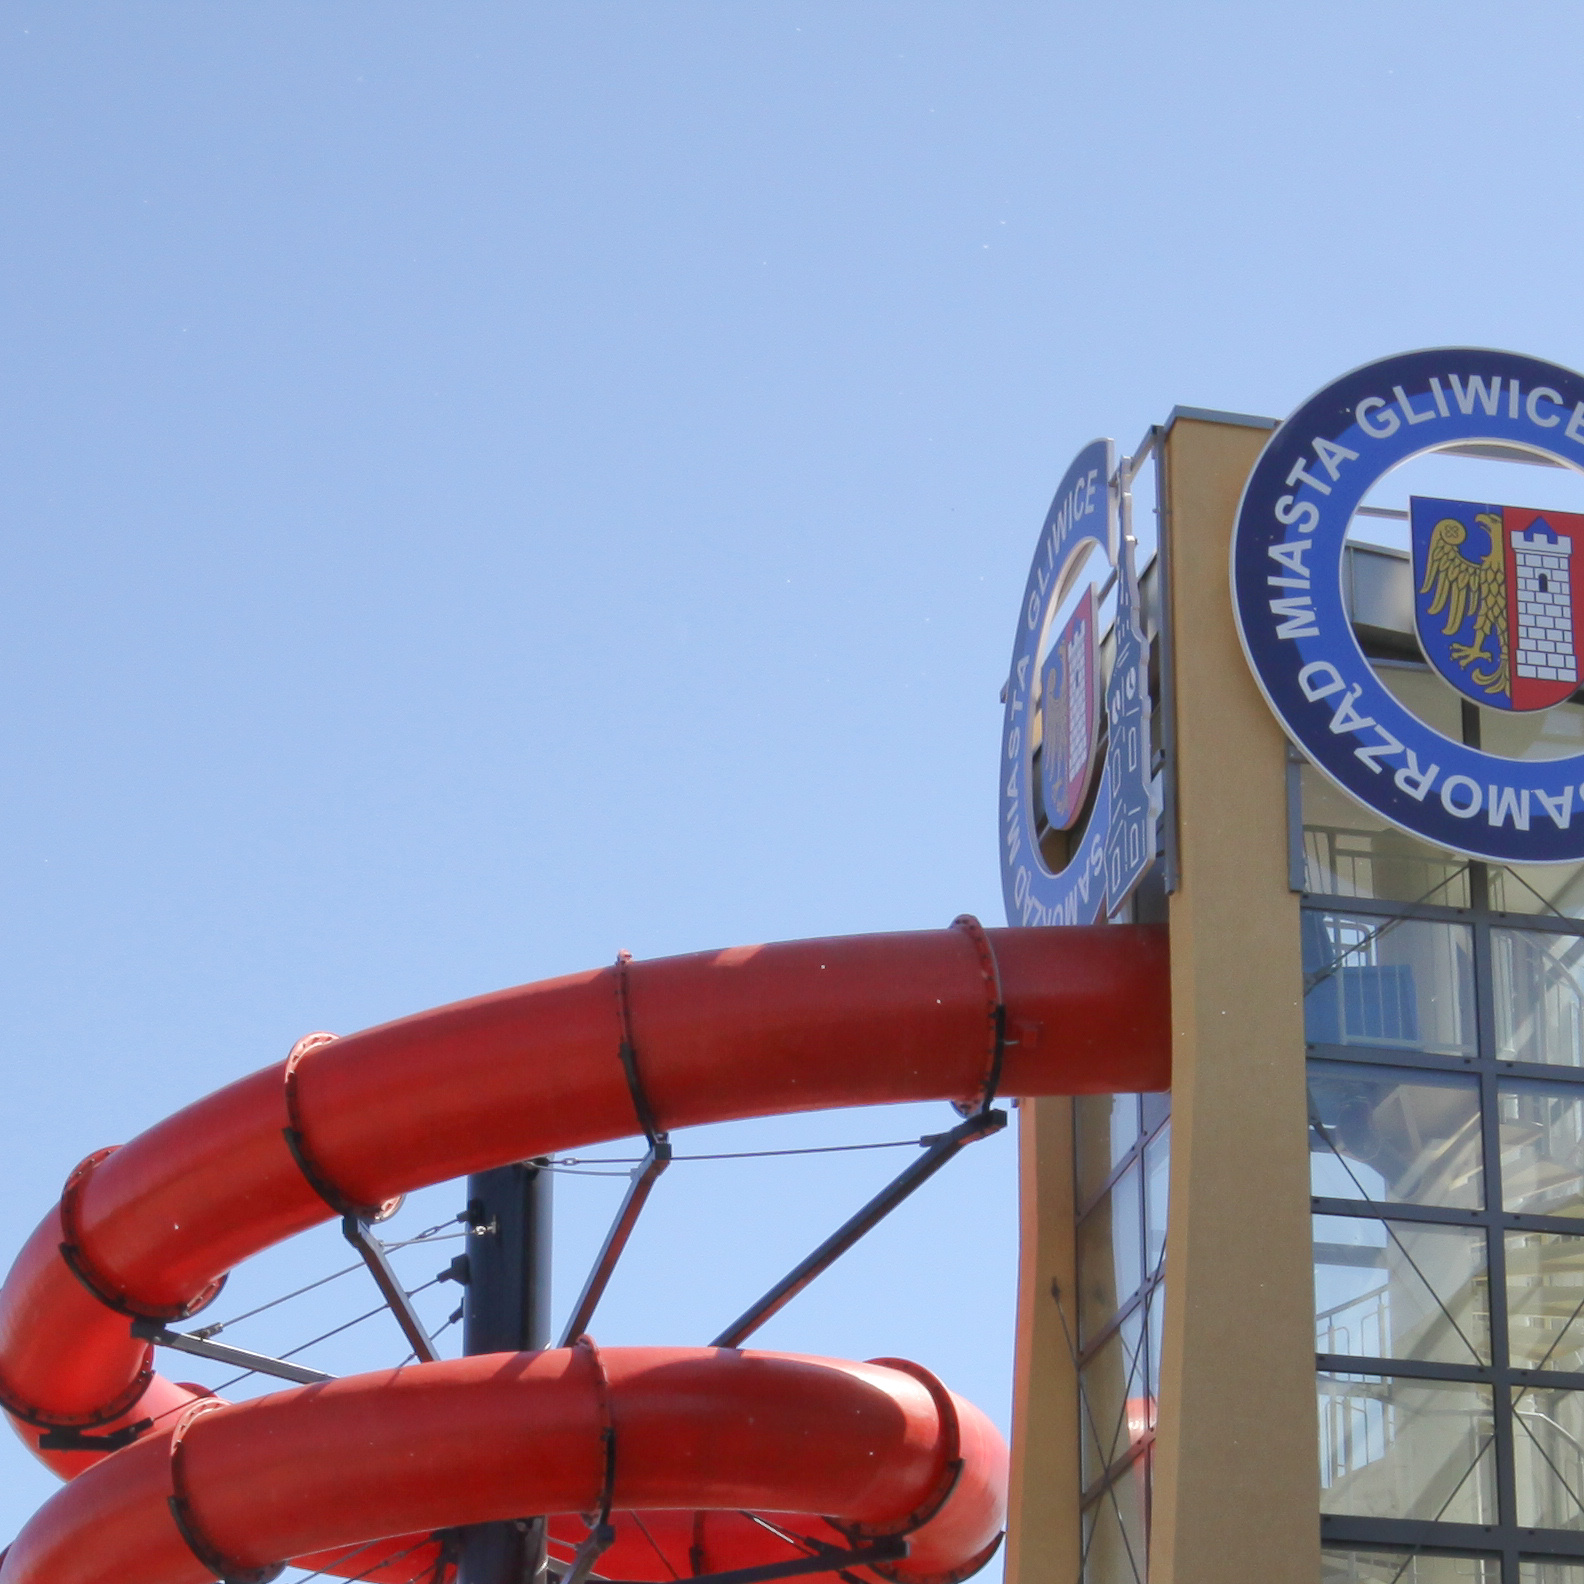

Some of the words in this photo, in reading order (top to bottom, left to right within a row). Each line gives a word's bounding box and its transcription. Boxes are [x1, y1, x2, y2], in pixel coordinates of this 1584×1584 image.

[1006, 655, 1030, 866] MIASTA
[1027, 469, 1098, 631] GLIWICE
[1267, 436, 1360, 639] MIASTA
